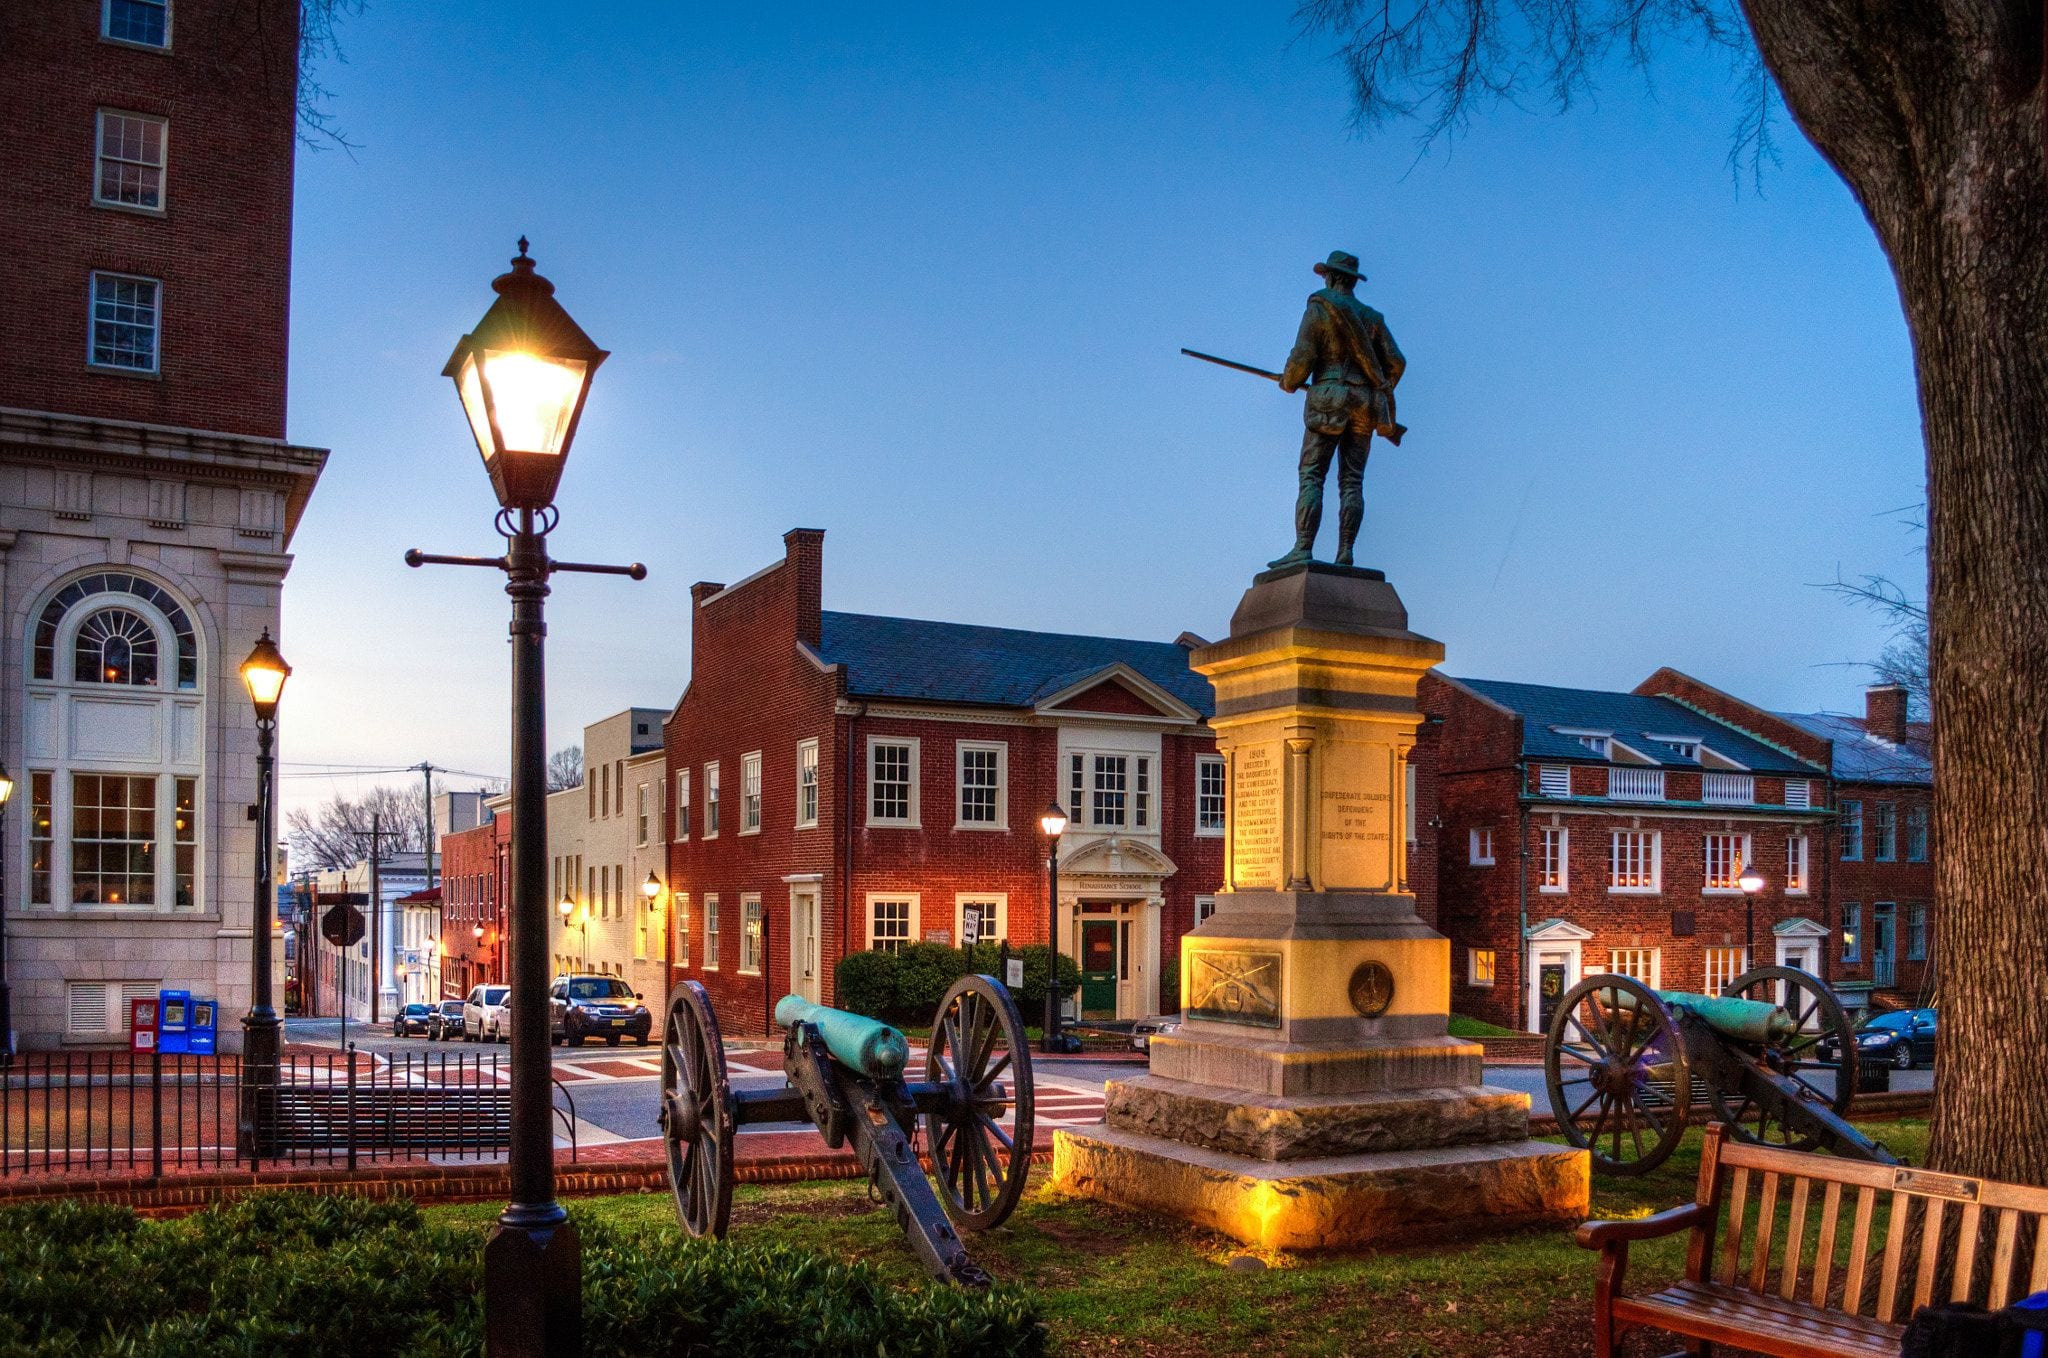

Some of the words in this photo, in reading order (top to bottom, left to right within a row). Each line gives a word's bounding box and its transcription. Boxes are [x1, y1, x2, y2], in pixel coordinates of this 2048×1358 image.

[1321, 792, 1361, 800] CONFEDERATE
[1355, 832, 1365, 840] THE
[1120, 882, 1142, 890] SCHOOL
[967, 912, 977, 921] ONE
